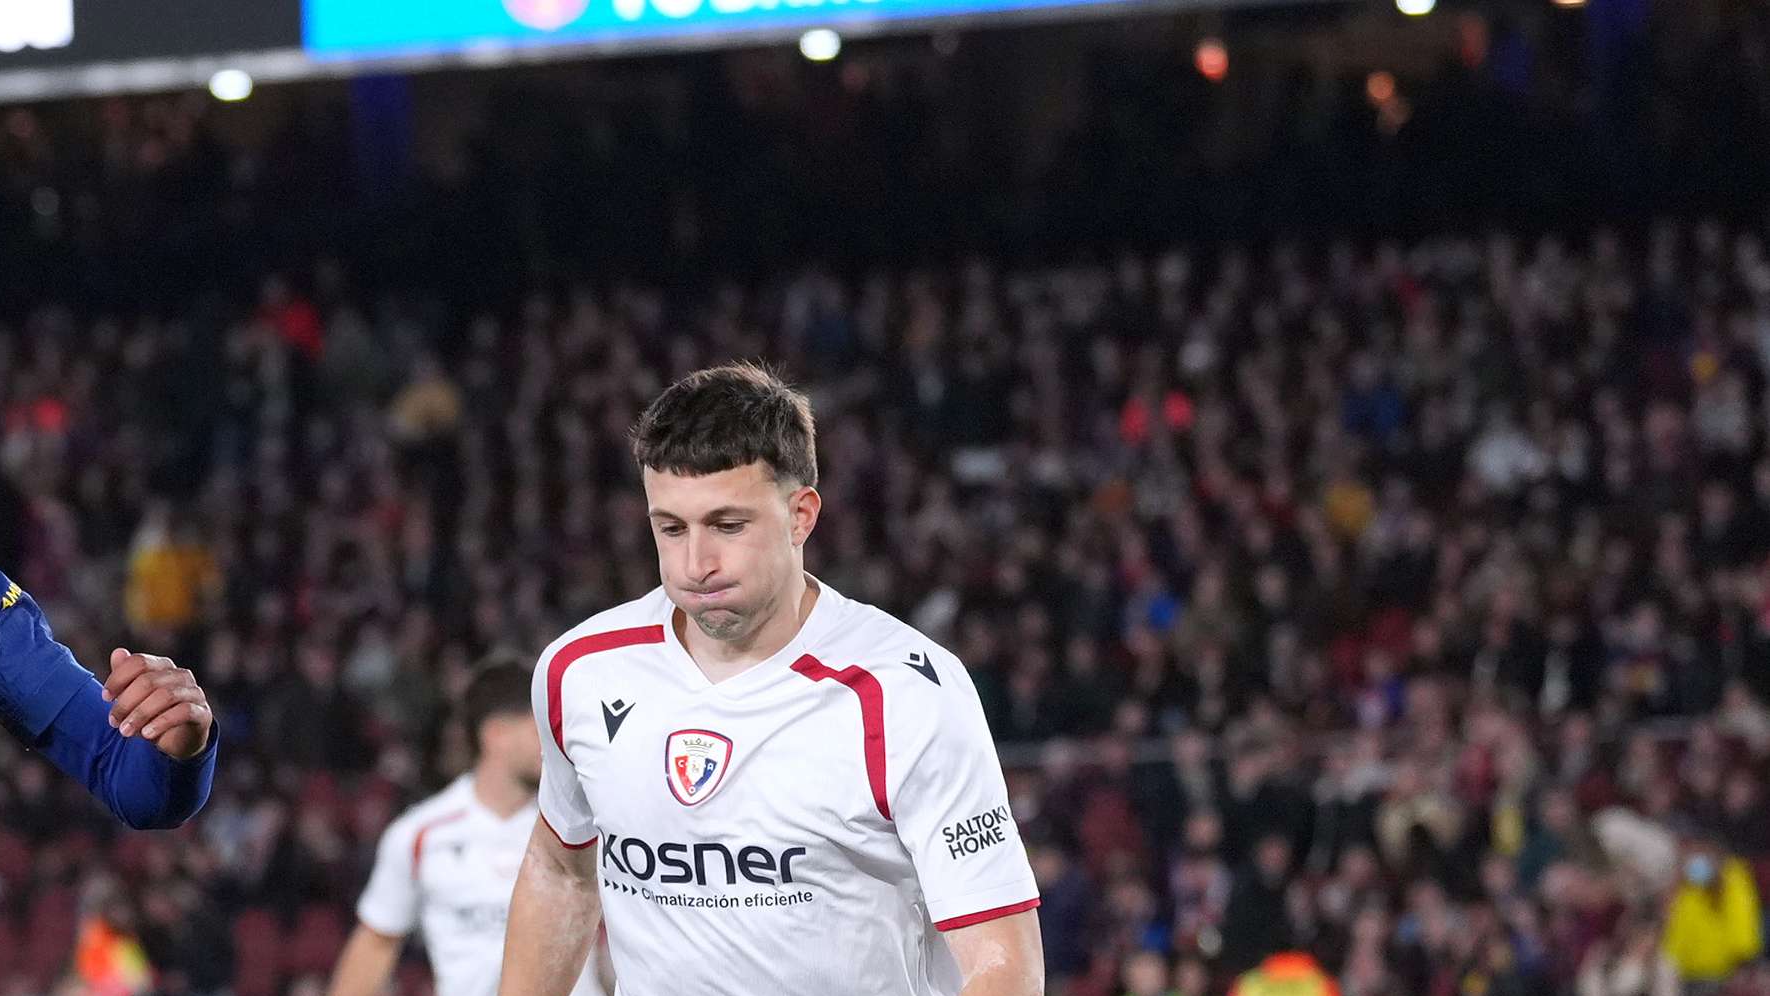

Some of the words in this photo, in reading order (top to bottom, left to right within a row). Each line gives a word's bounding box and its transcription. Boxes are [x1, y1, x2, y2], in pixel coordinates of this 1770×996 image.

[601, 833, 807, 886] Kosner
[948, 826, 1006, 860] HOME
[744, 890, 814, 907] eficiente
